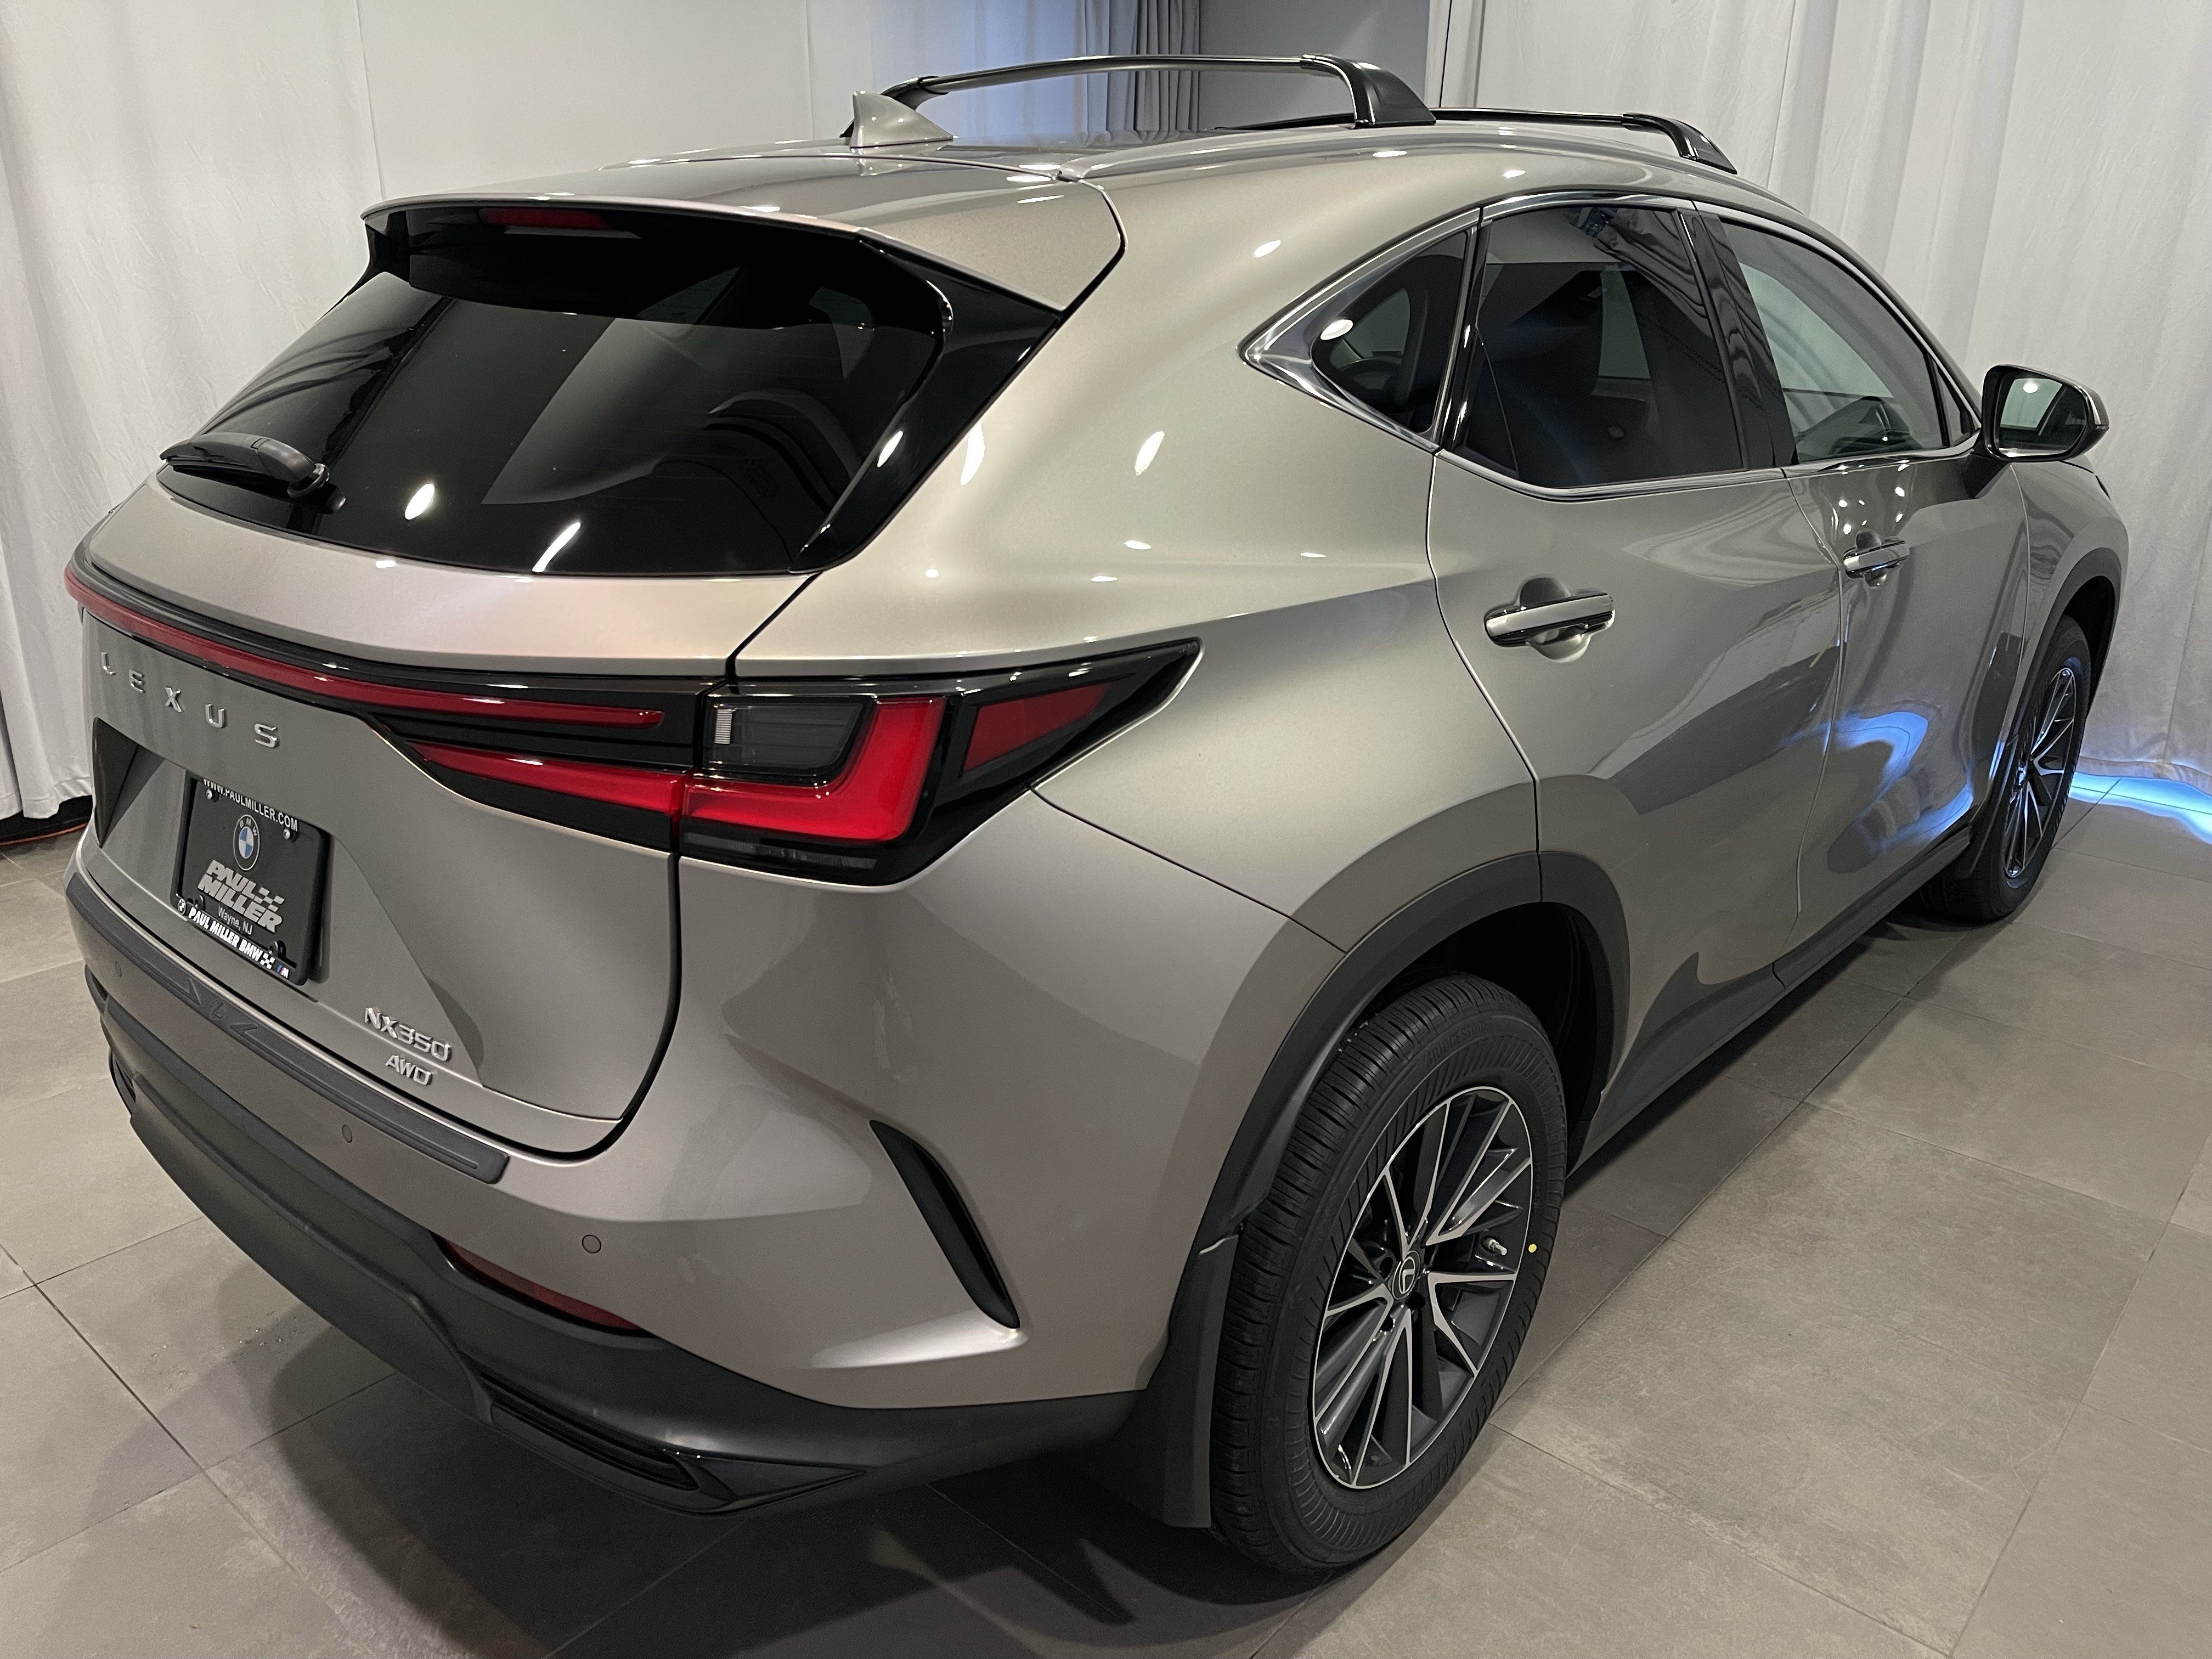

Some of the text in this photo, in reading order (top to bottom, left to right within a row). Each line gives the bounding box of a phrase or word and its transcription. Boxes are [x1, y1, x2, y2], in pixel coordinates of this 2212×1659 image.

[101, 652, 279, 748] LEXUS
[204, 778, 298, 832] WWW.PAULMILLER.COM
[198, 874, 283, 933] MILLER
[206, 860, 256, 900] PAUL
[188, 907, 210, 929] PAUL
[209, 921, 240, 948] MILLER
[239, 939, 263, 961] BMW
[218, 906, 253, 935] Wayne, NJ
[365, 1007, 452, 1062] NX350
[385, 1055, 432, 1085] AWD
